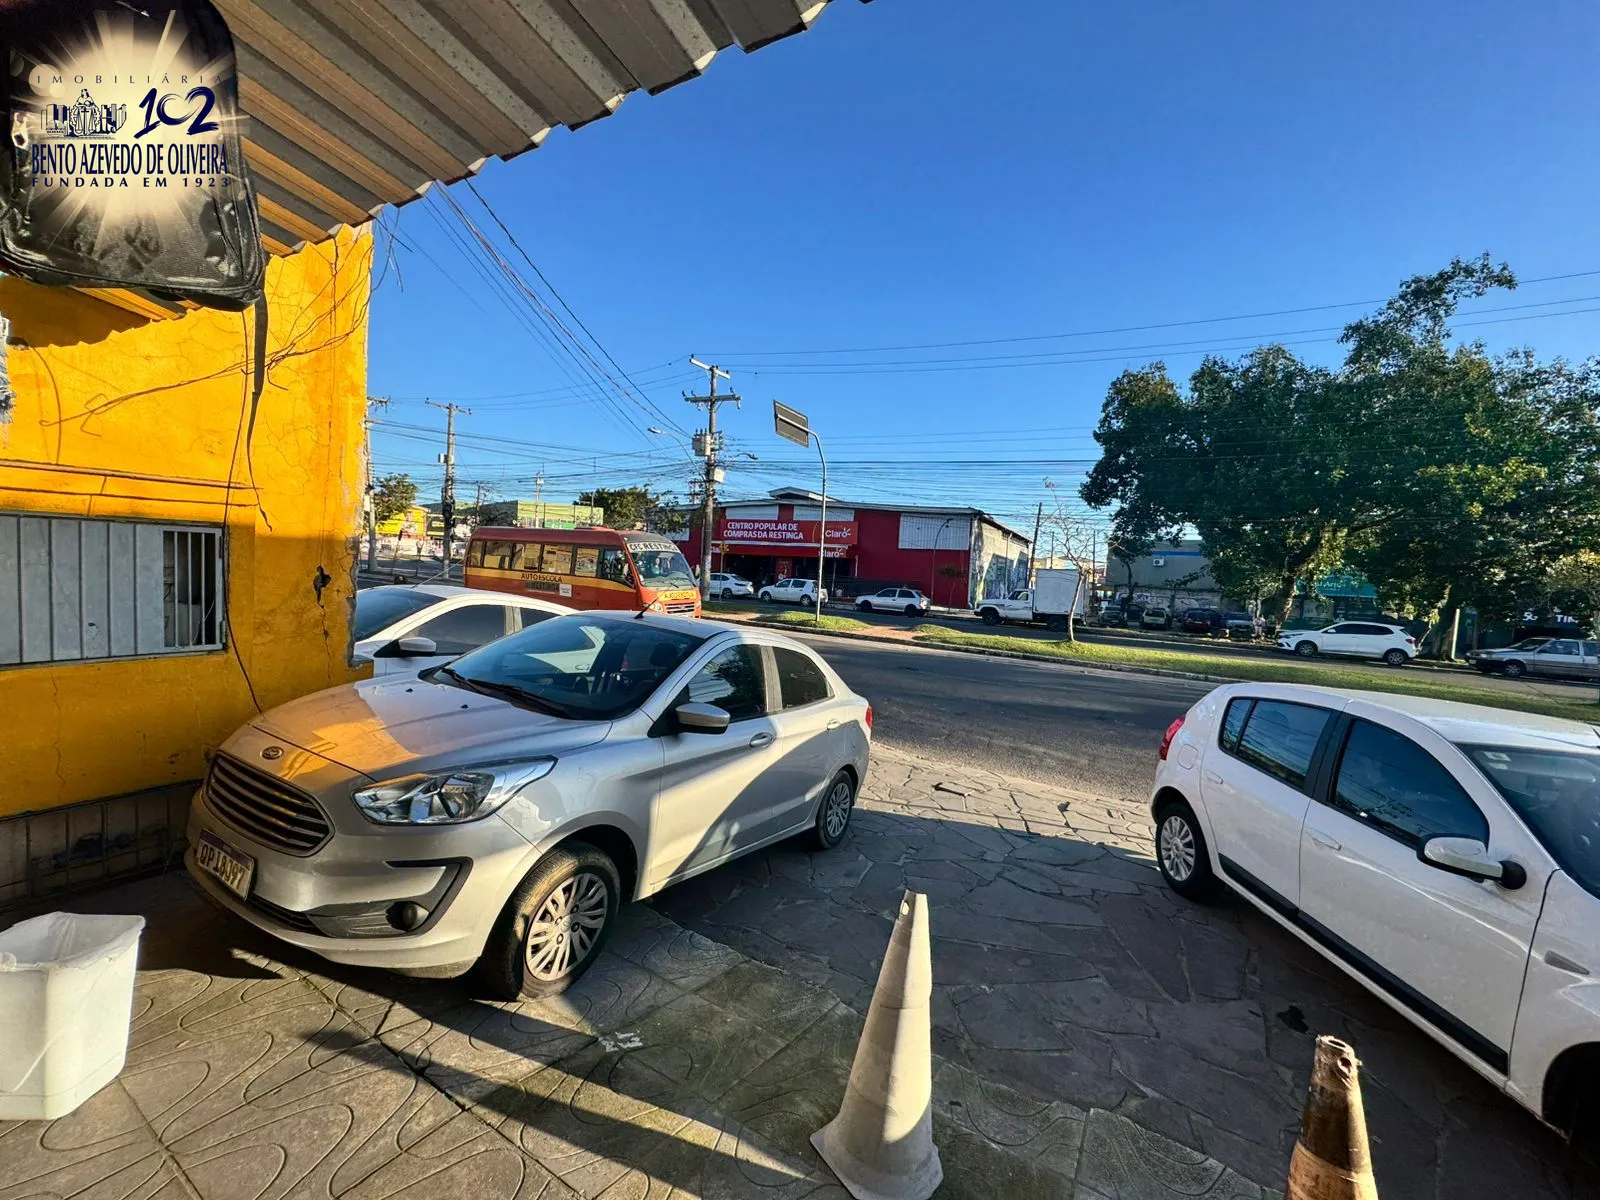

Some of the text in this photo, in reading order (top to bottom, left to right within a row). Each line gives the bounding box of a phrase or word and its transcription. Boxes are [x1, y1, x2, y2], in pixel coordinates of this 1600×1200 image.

[727, 521, 798, 531] CENTRO POPULAR DE
[723, 530, 804, 540] COMPRAS DA RESTINGA
[825, 529, 848, 538] Claro
